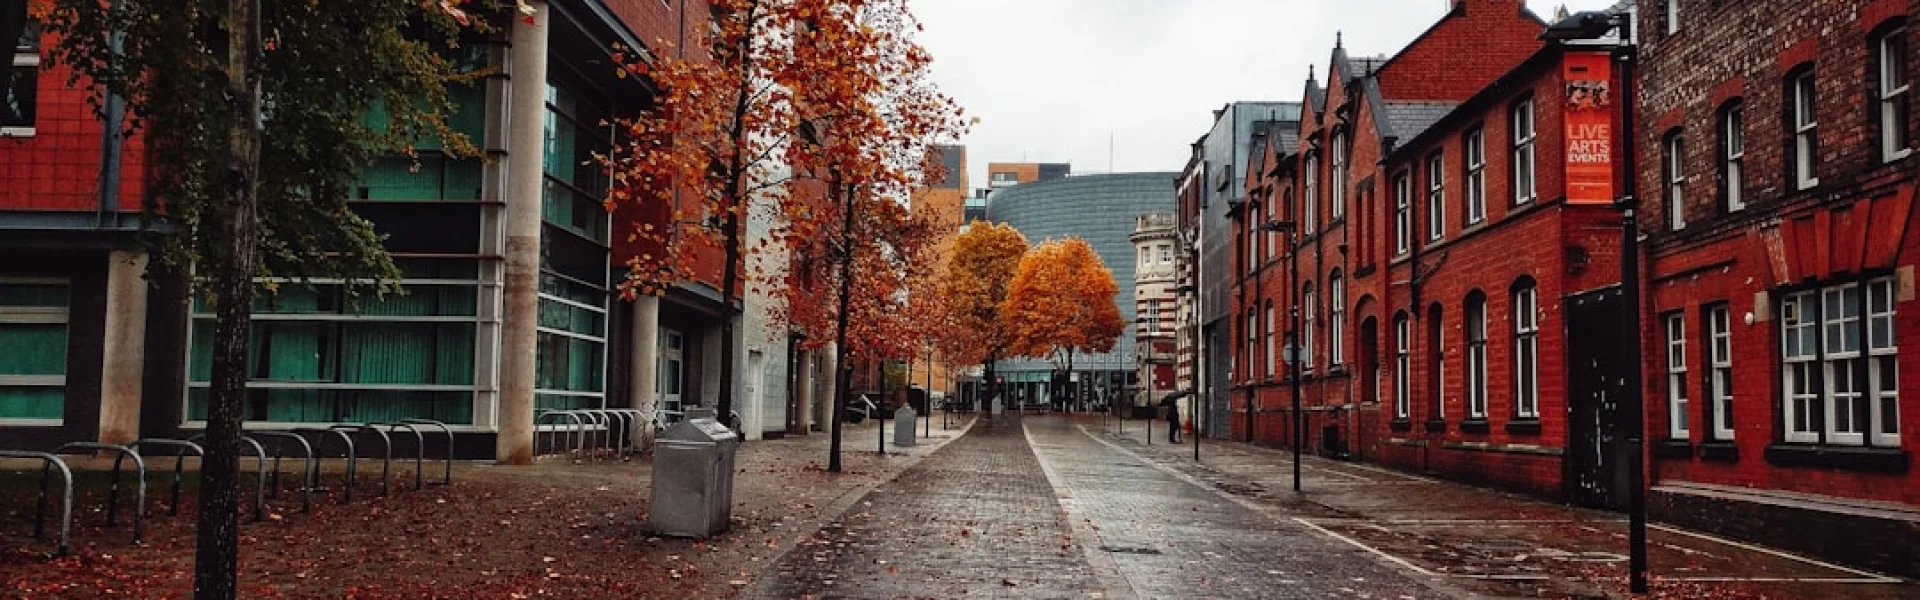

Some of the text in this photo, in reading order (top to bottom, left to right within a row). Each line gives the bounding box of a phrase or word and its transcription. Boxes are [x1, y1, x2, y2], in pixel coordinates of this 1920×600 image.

[1568, 124, 1609, 139] LIVE
[1569, 140, 1610, 153] ARTS
[1567, 153, 1610, 163] EVENTS
